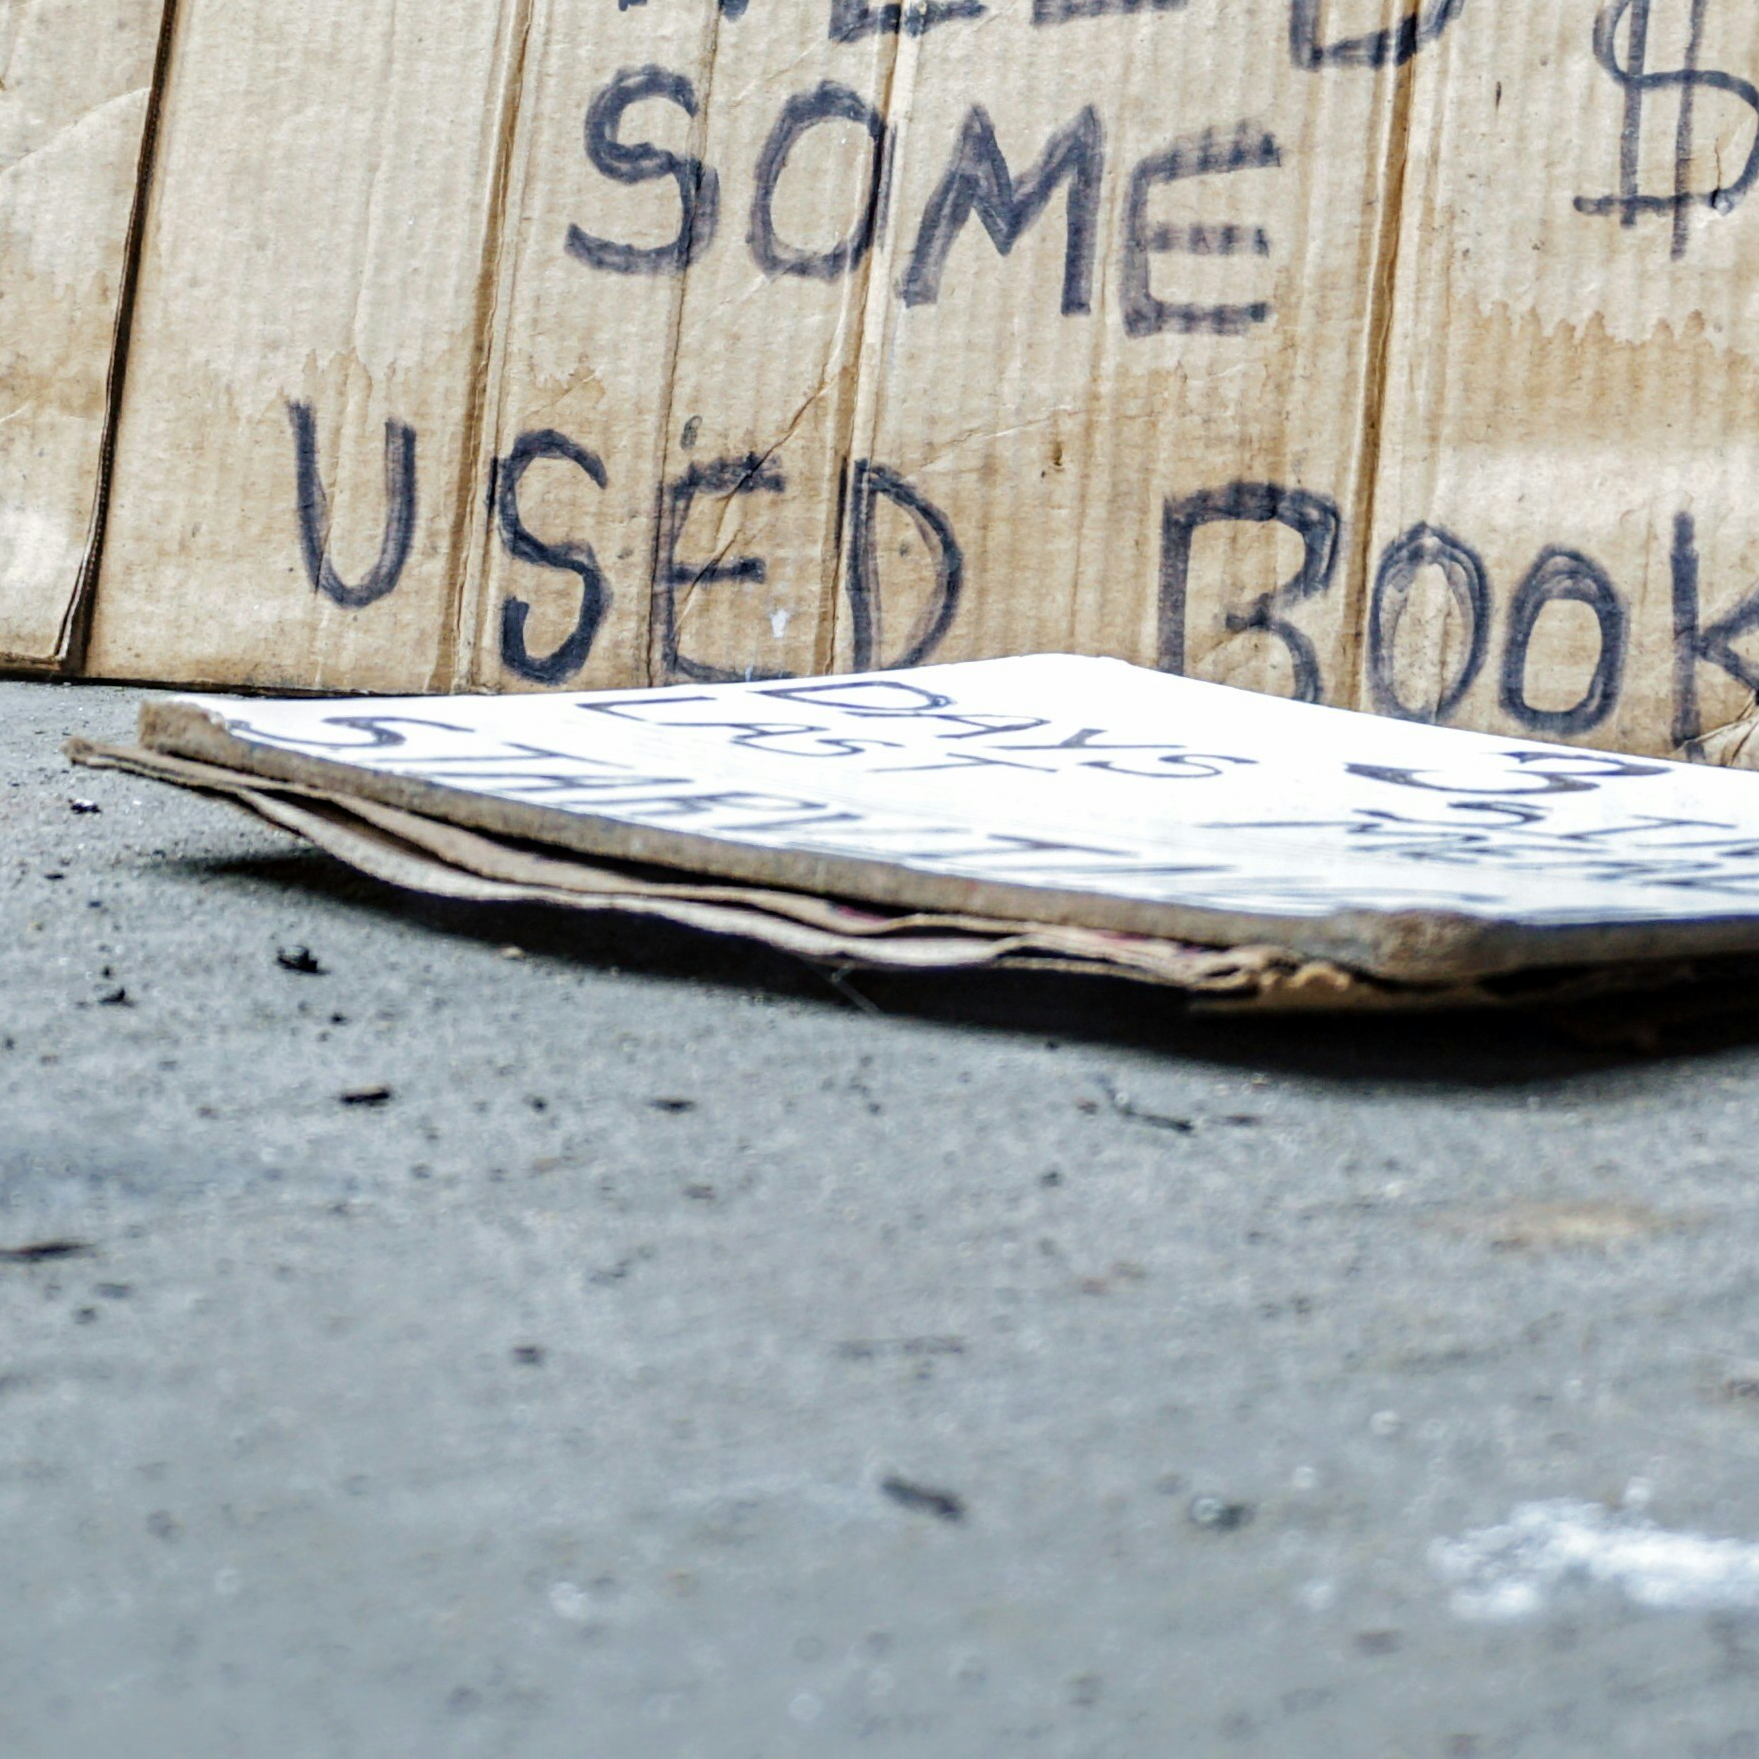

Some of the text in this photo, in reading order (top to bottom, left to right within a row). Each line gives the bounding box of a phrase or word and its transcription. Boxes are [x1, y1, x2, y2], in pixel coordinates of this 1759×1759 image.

[561, 64, 1283, 339] SOME
[286, 401, 965, 685] USED
[574, 695, 1059, 773] LAST
[746, 680, 1259, 778] DAYS
